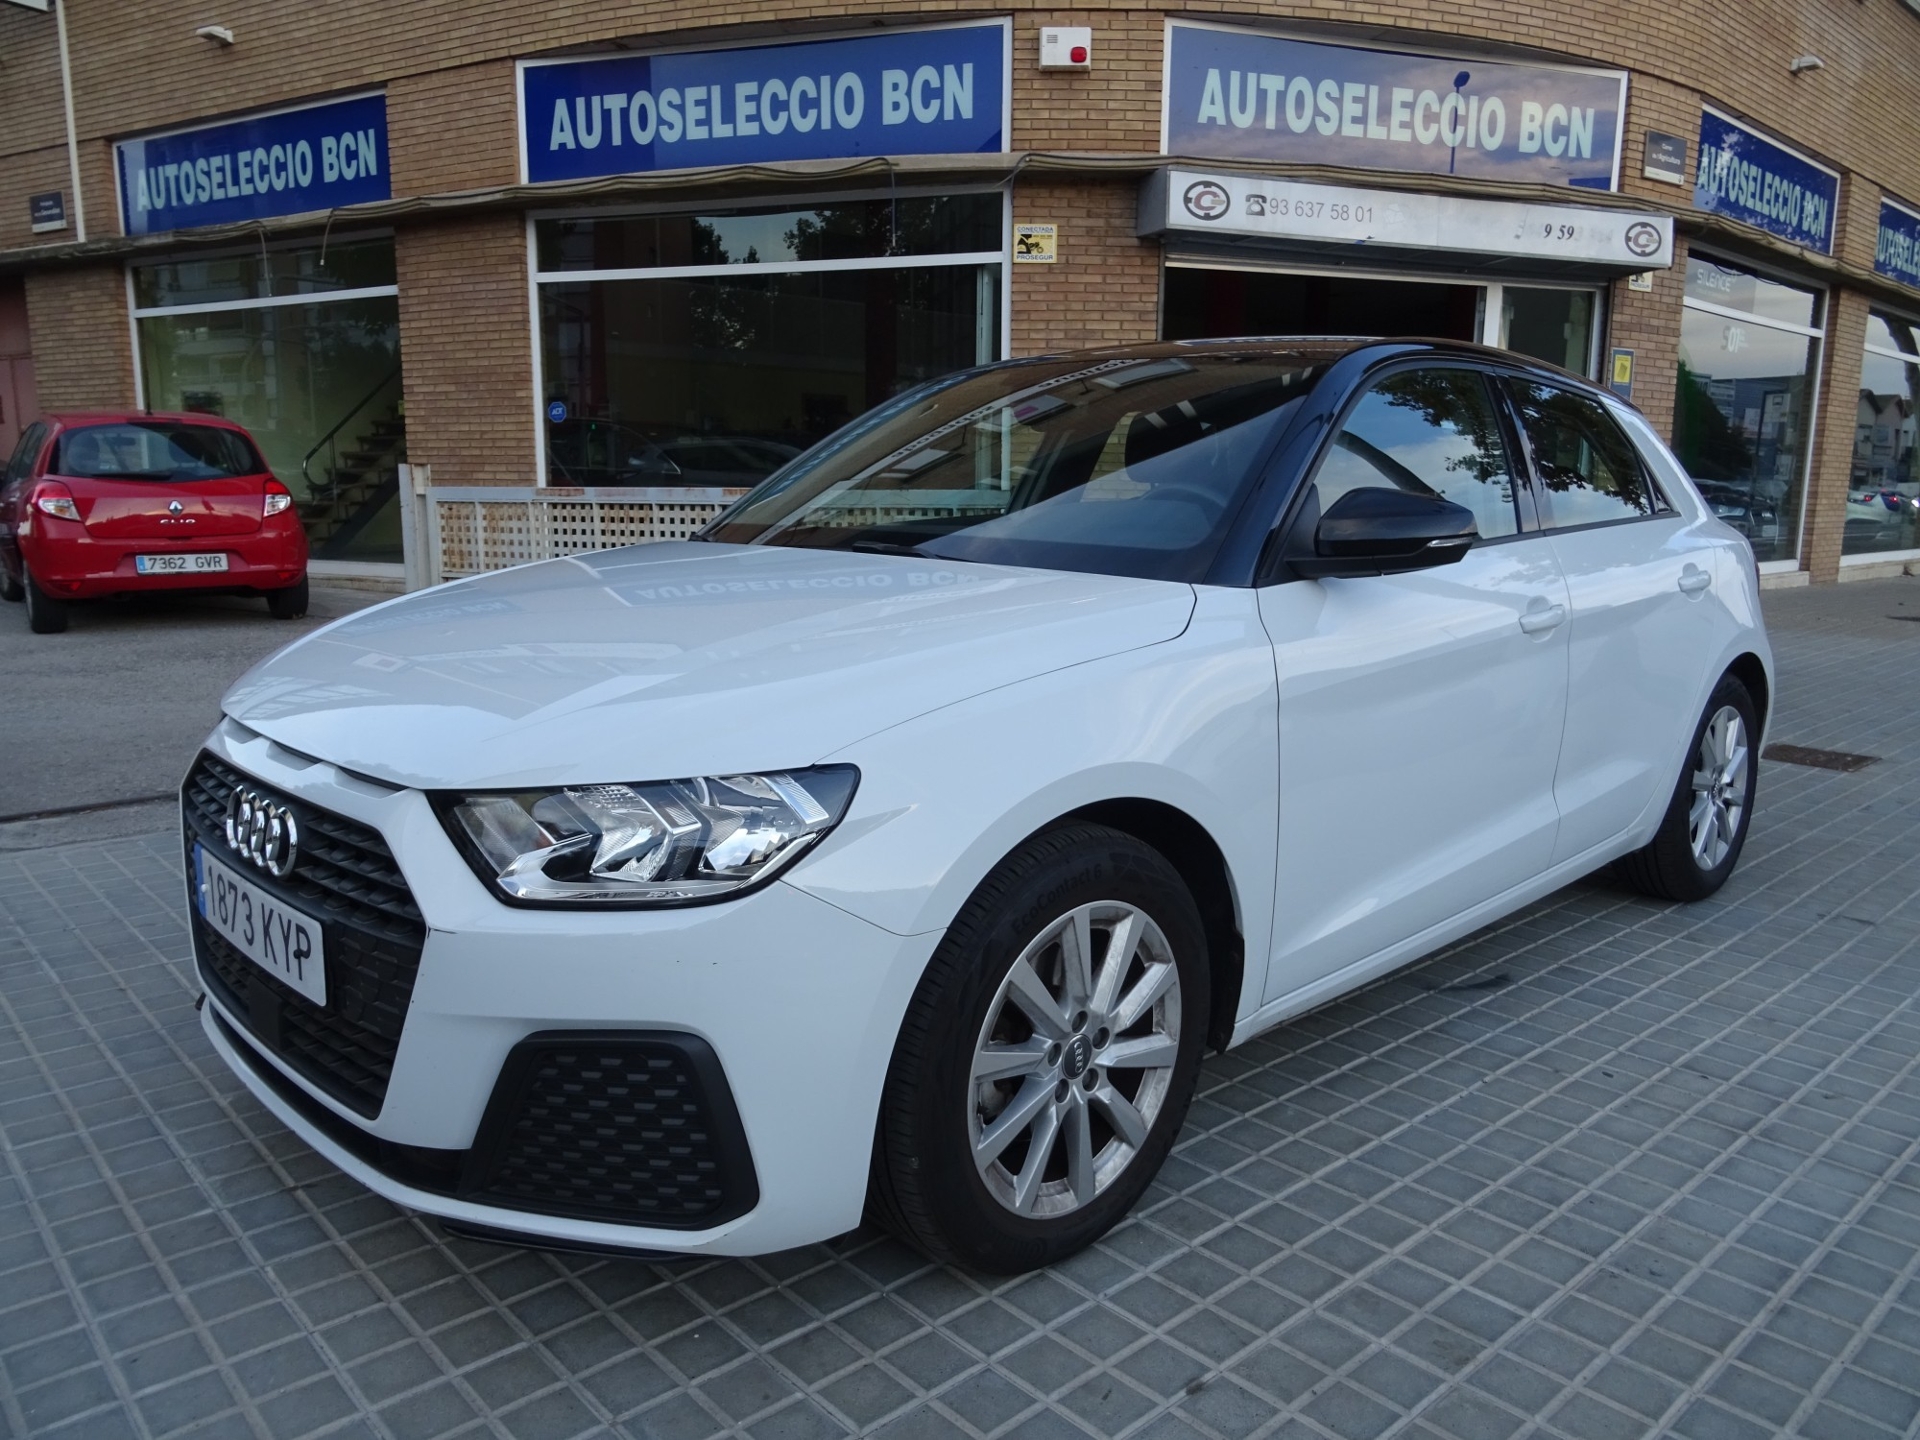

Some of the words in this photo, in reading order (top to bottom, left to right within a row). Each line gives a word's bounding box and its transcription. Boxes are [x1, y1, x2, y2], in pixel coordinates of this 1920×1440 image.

[550, 72, 864, 151] AUTOSELECCIO
[882, 63, 973, 126] BCN
[1197, 68, 1506, 151] AUTOSELECCIO
[1518, 101, 1595, 159] BCN
[137, 139, 313, 212] AUTOSELECCIO
[321, 128, 378, 183] BCN
[1269, 198, 1290, 216] 93
[1294, 200, 1325, 219] 637
[1330, 204, 1350, 221] 58
[1355, 206, 1374, 223] 01
[1698, 143, 1800, 227] AUTOSELECCIO
[1802, 190, 1828, 238] BCN
[148, 557, 186, 571] 7362
[195, 555, 222, 570] GVR
[208, 865, 255, 947] 1873
[261, 902, 312, 981] KYP
[1011, 867, 1091, 936] EcoContact
[1093, 863, 1102, 880] 6
